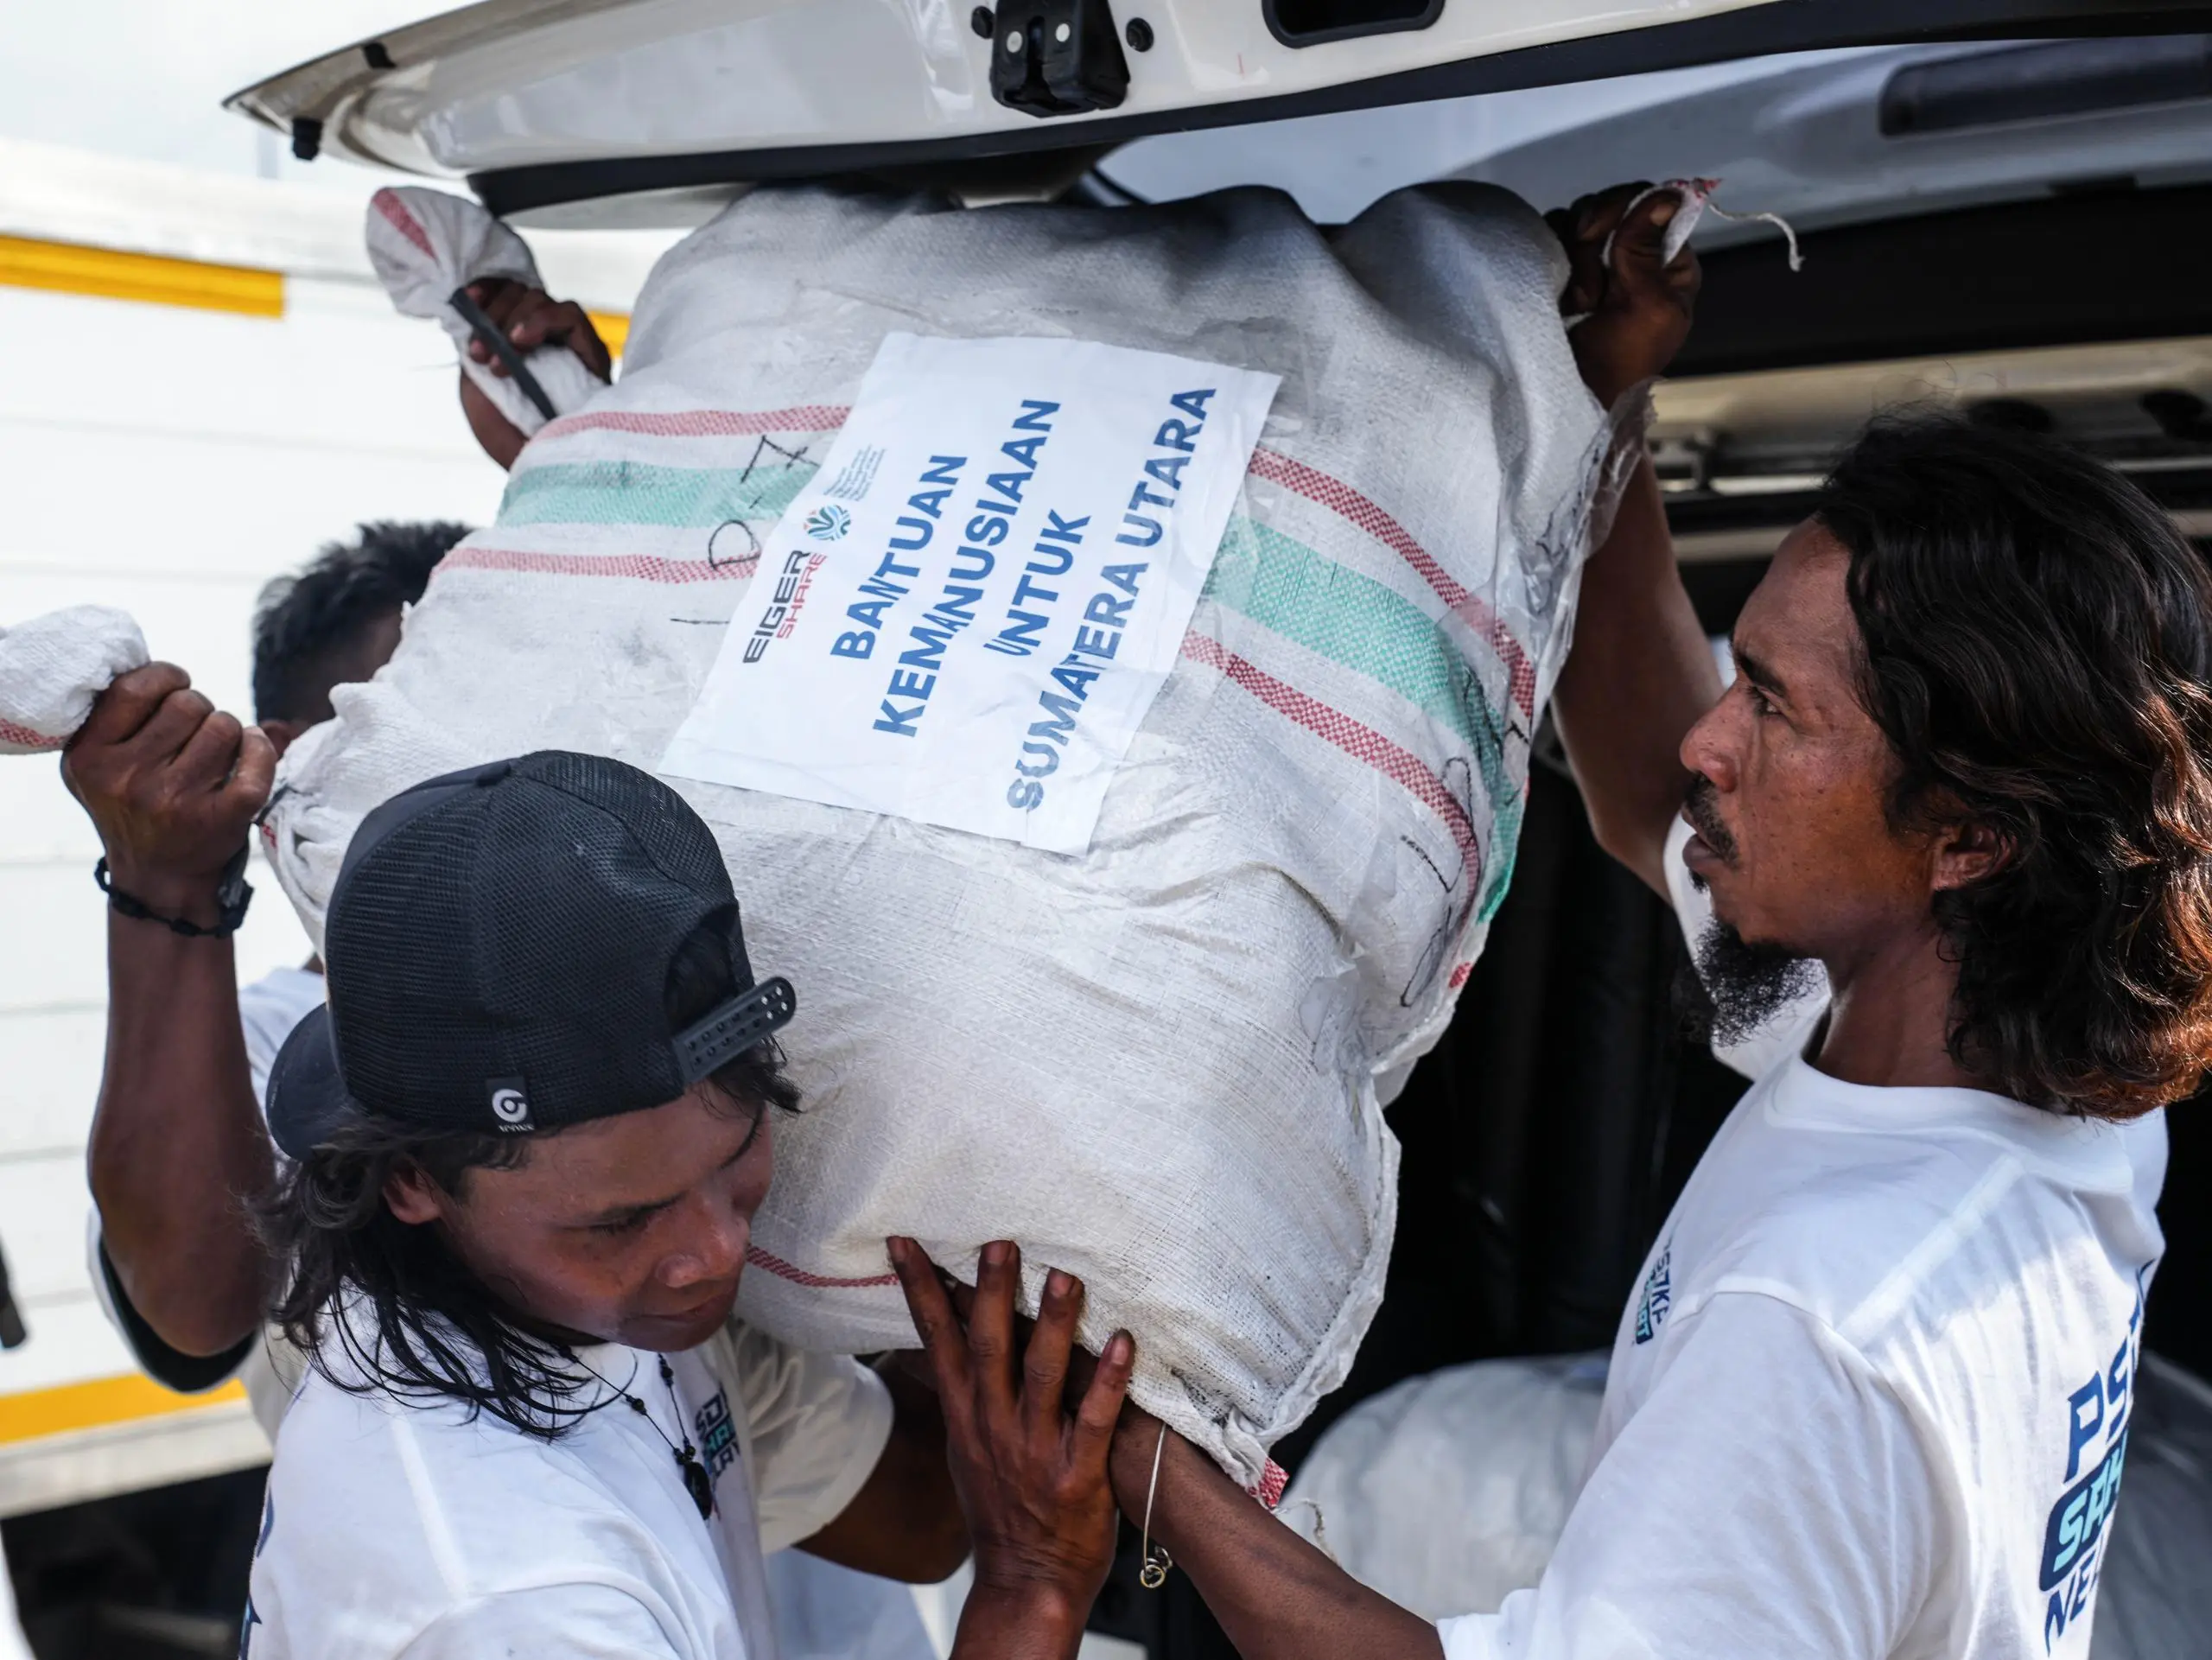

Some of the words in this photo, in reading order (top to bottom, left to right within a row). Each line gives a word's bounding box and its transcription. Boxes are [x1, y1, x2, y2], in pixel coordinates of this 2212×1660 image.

[743, 550, 810, 663] EIGER
[776, 553, 827, 639] SHARE
[830, 455, 969, 660] BANTUAN
[873, 398, 1062, 737] KEMANUSIAAN
[983, 508, 1091, 657] UNTUK
[1007, 563, 1149, 812] SUMATERA
[1116, 388, 1217, 548] UTARA
